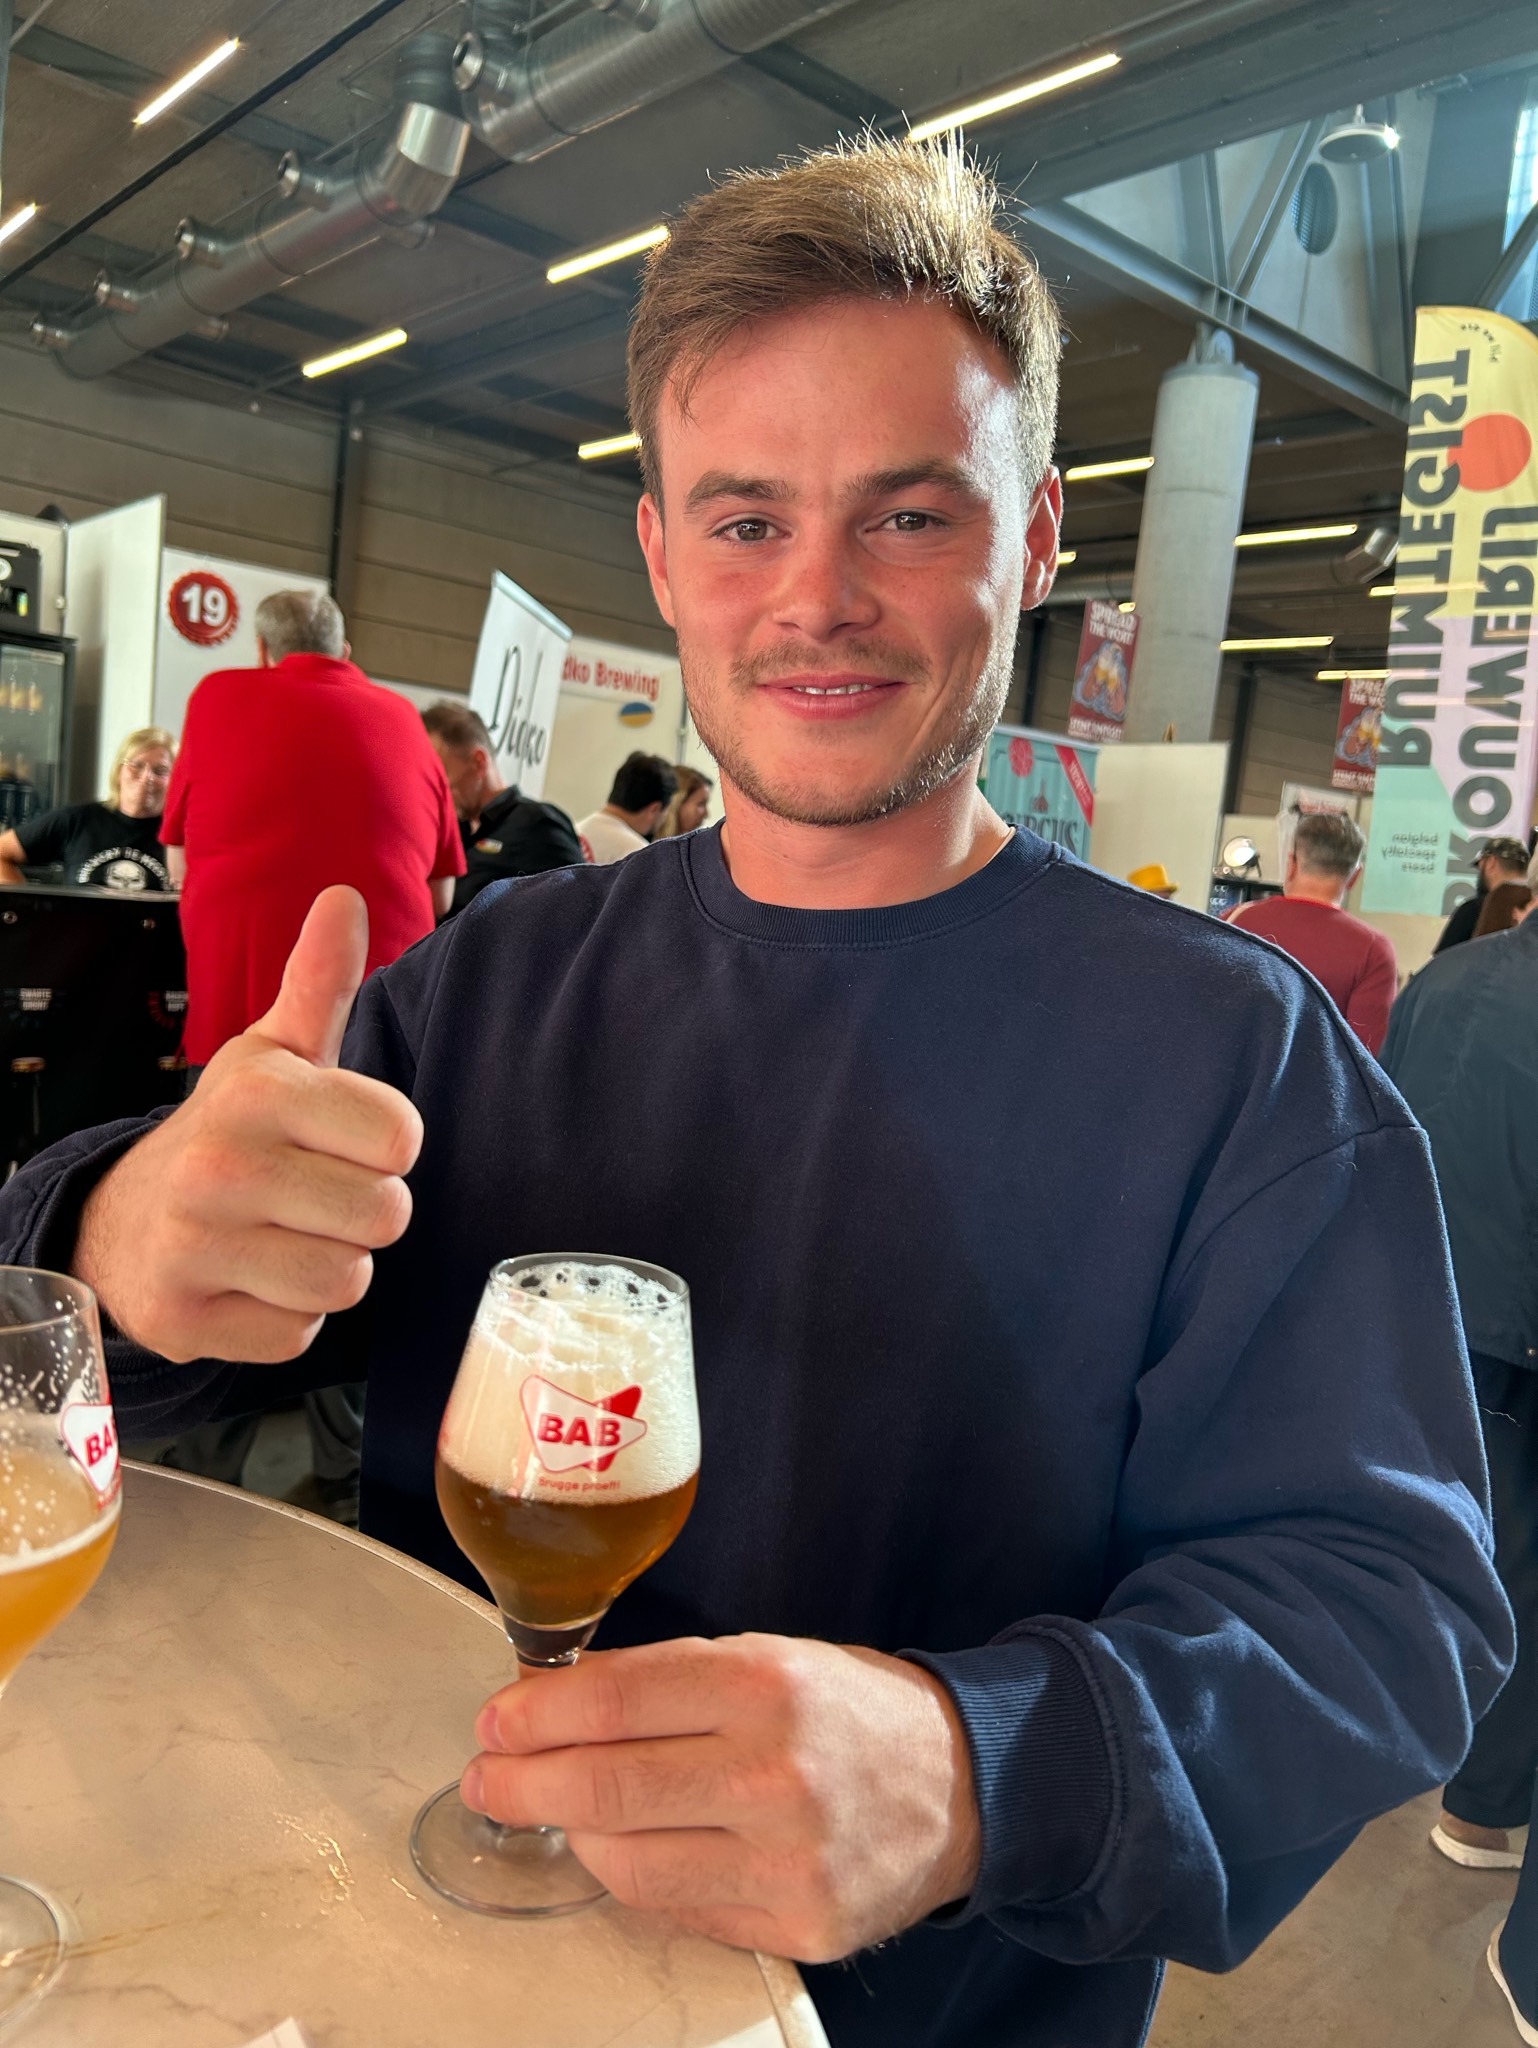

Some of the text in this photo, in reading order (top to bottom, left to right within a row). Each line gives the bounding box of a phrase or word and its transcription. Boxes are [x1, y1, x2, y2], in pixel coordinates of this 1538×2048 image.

[182, 583, 228, 627] 19
[595, 660, 660, 701] Brewing
[538, 1413, 621, 1447] BAB
